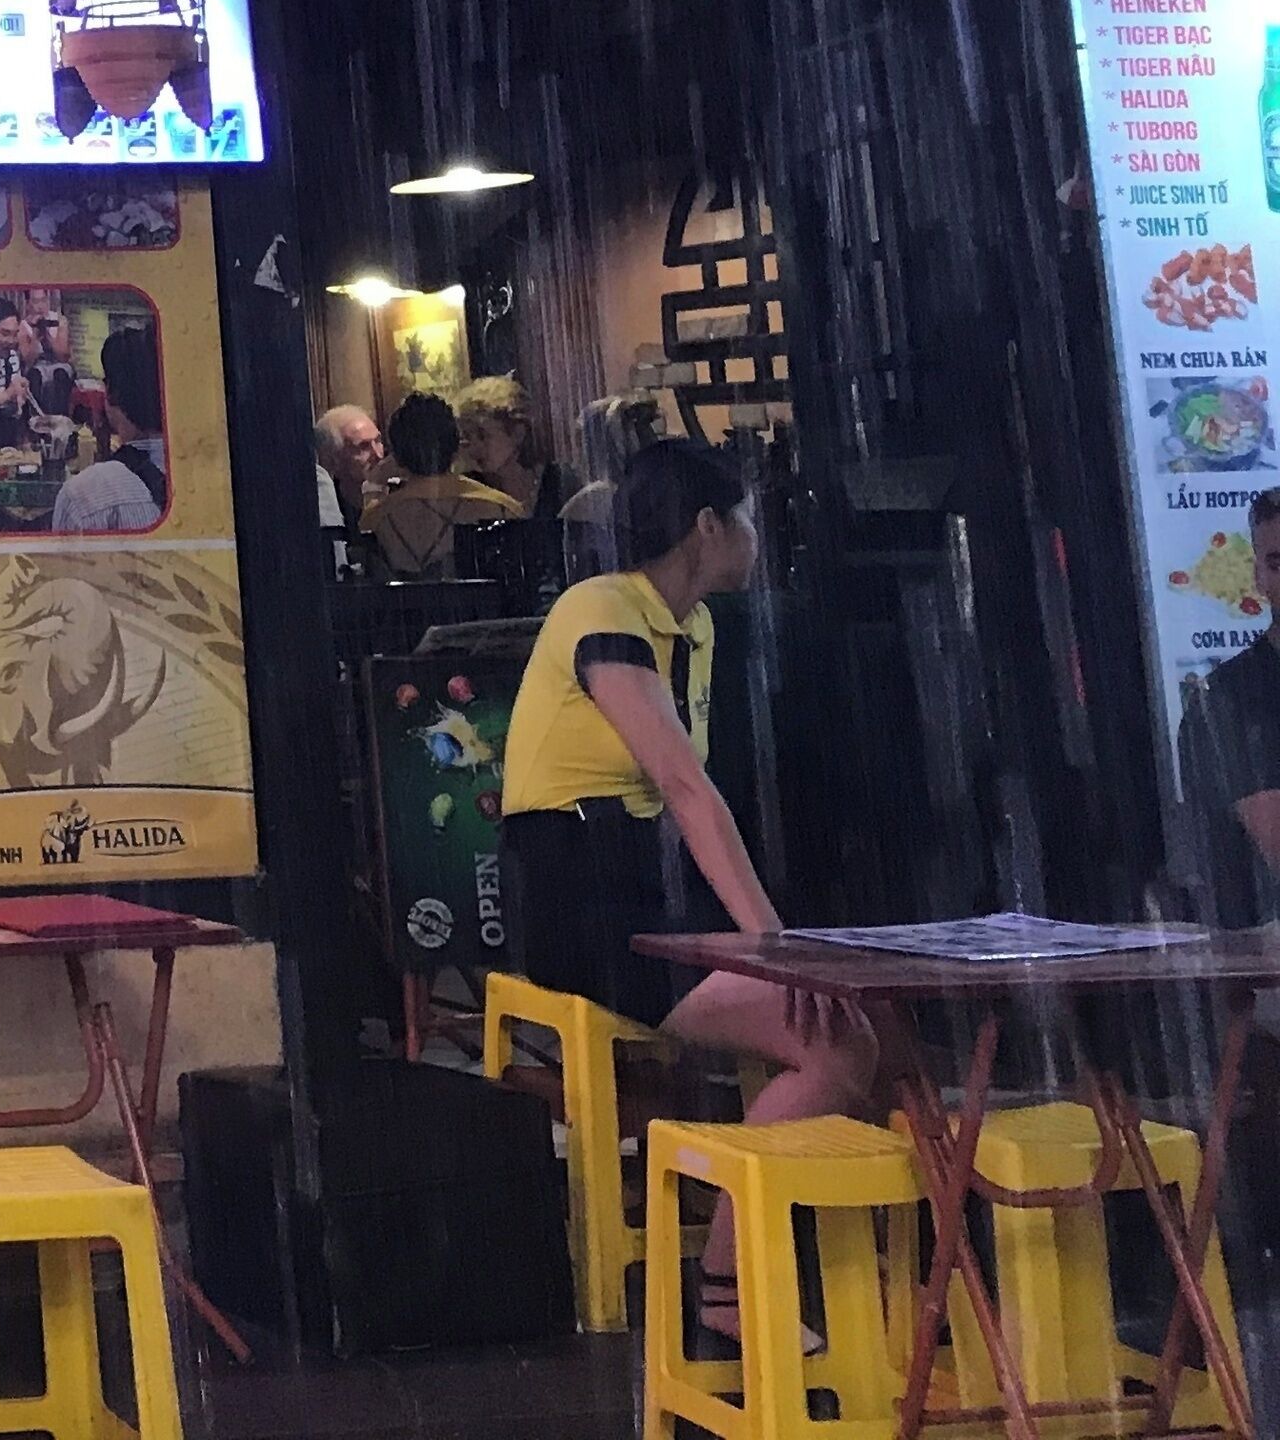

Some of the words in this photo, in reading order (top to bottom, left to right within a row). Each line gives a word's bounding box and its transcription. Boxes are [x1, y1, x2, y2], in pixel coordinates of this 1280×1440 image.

[1114, 26, 1169, 45] TIGER
[1175, 26, 1212, 48] BẠC
[1117, 58, 1173, 76] TIGER
[1121, 90, 1189, 109] HALIDA
[1124, 121, 1198, 140] TUBORG
[1129, 185, 1168, 205] JUICE
[1172, 184, 1205, 205] SINH
[1137, 216, 1180, 236] SINH
[1141, 352, 1177, 369] NEM
[1180, 351, 1228, 368] CHUA
[92, 825, 186, 850] HALIDA
[474, 850, 505, 948] OPEN
